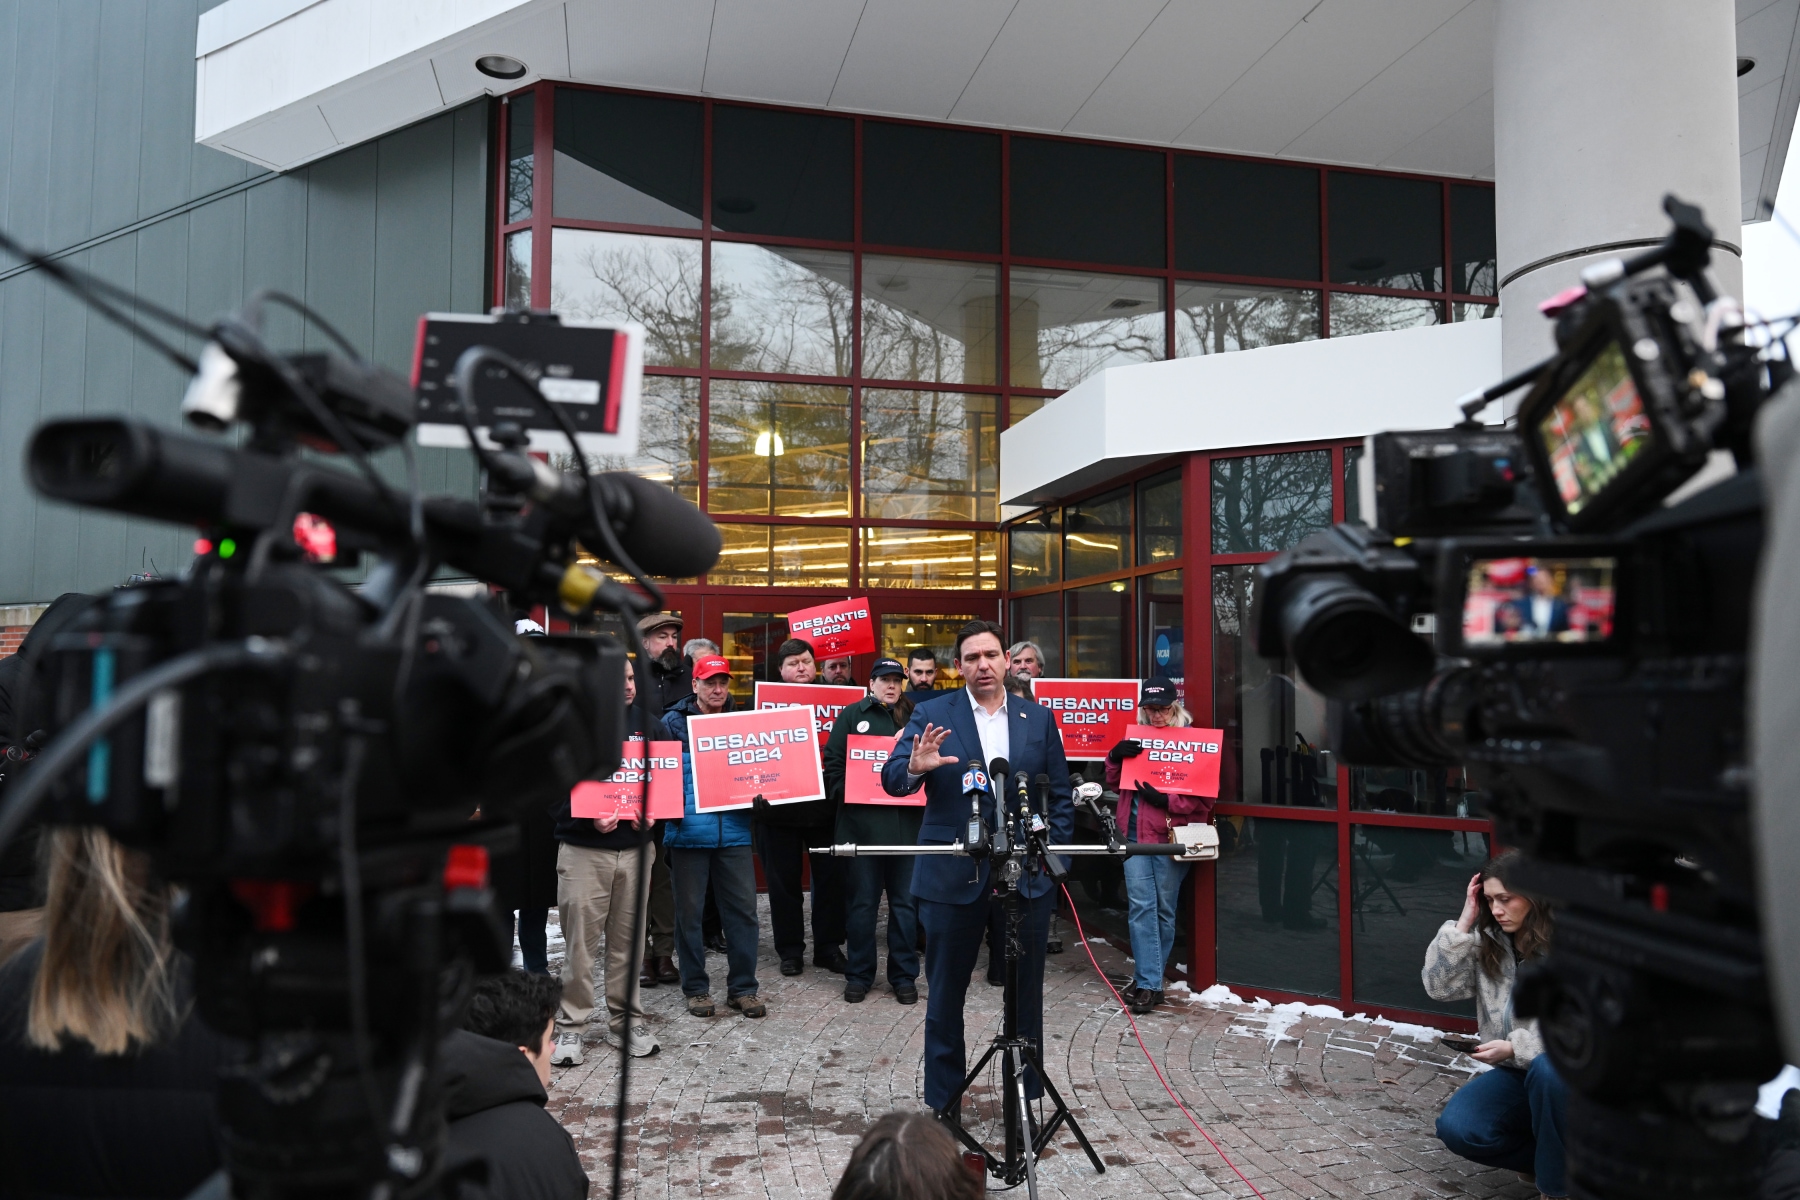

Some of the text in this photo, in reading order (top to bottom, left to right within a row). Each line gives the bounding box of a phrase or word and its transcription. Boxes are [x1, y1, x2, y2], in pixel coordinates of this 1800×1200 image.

[792, 609, 868, 632] DESANTIS
[812, 622, 851, 638] 2024
[1038, 697, 1134, 711] DESANTIS
[1063, 712, 1109, 724] 2024
[697, 728, 809, 752] DESANTIS
[620, 757, 678, 769] ANTIS
[728, 747, 782, 766] 2024
[1148, 751, 1195, 764] 2024
